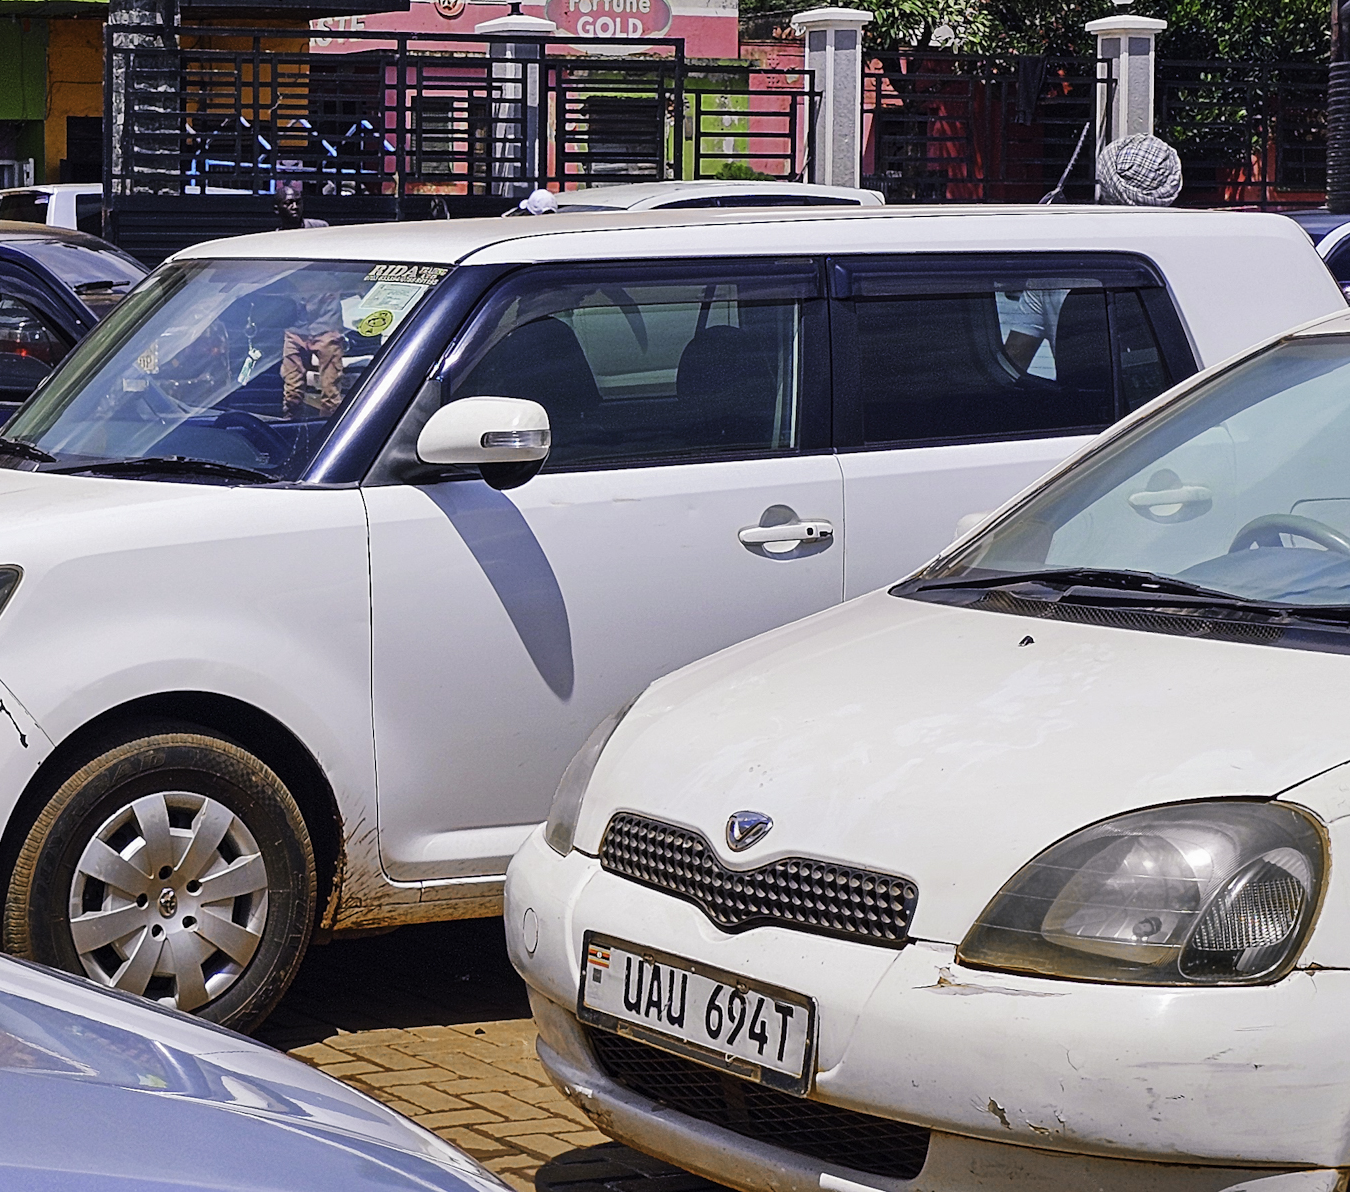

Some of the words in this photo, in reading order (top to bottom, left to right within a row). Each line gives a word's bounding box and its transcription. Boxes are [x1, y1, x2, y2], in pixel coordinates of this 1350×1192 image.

[309, 16, 367, 48] STE
[576, 16, 643, 38] GOLD
[368, 265, 419, 278] RIDA
[623, 955, 688, 1029] UAU
[705, 983, 794, 1063] 694T
